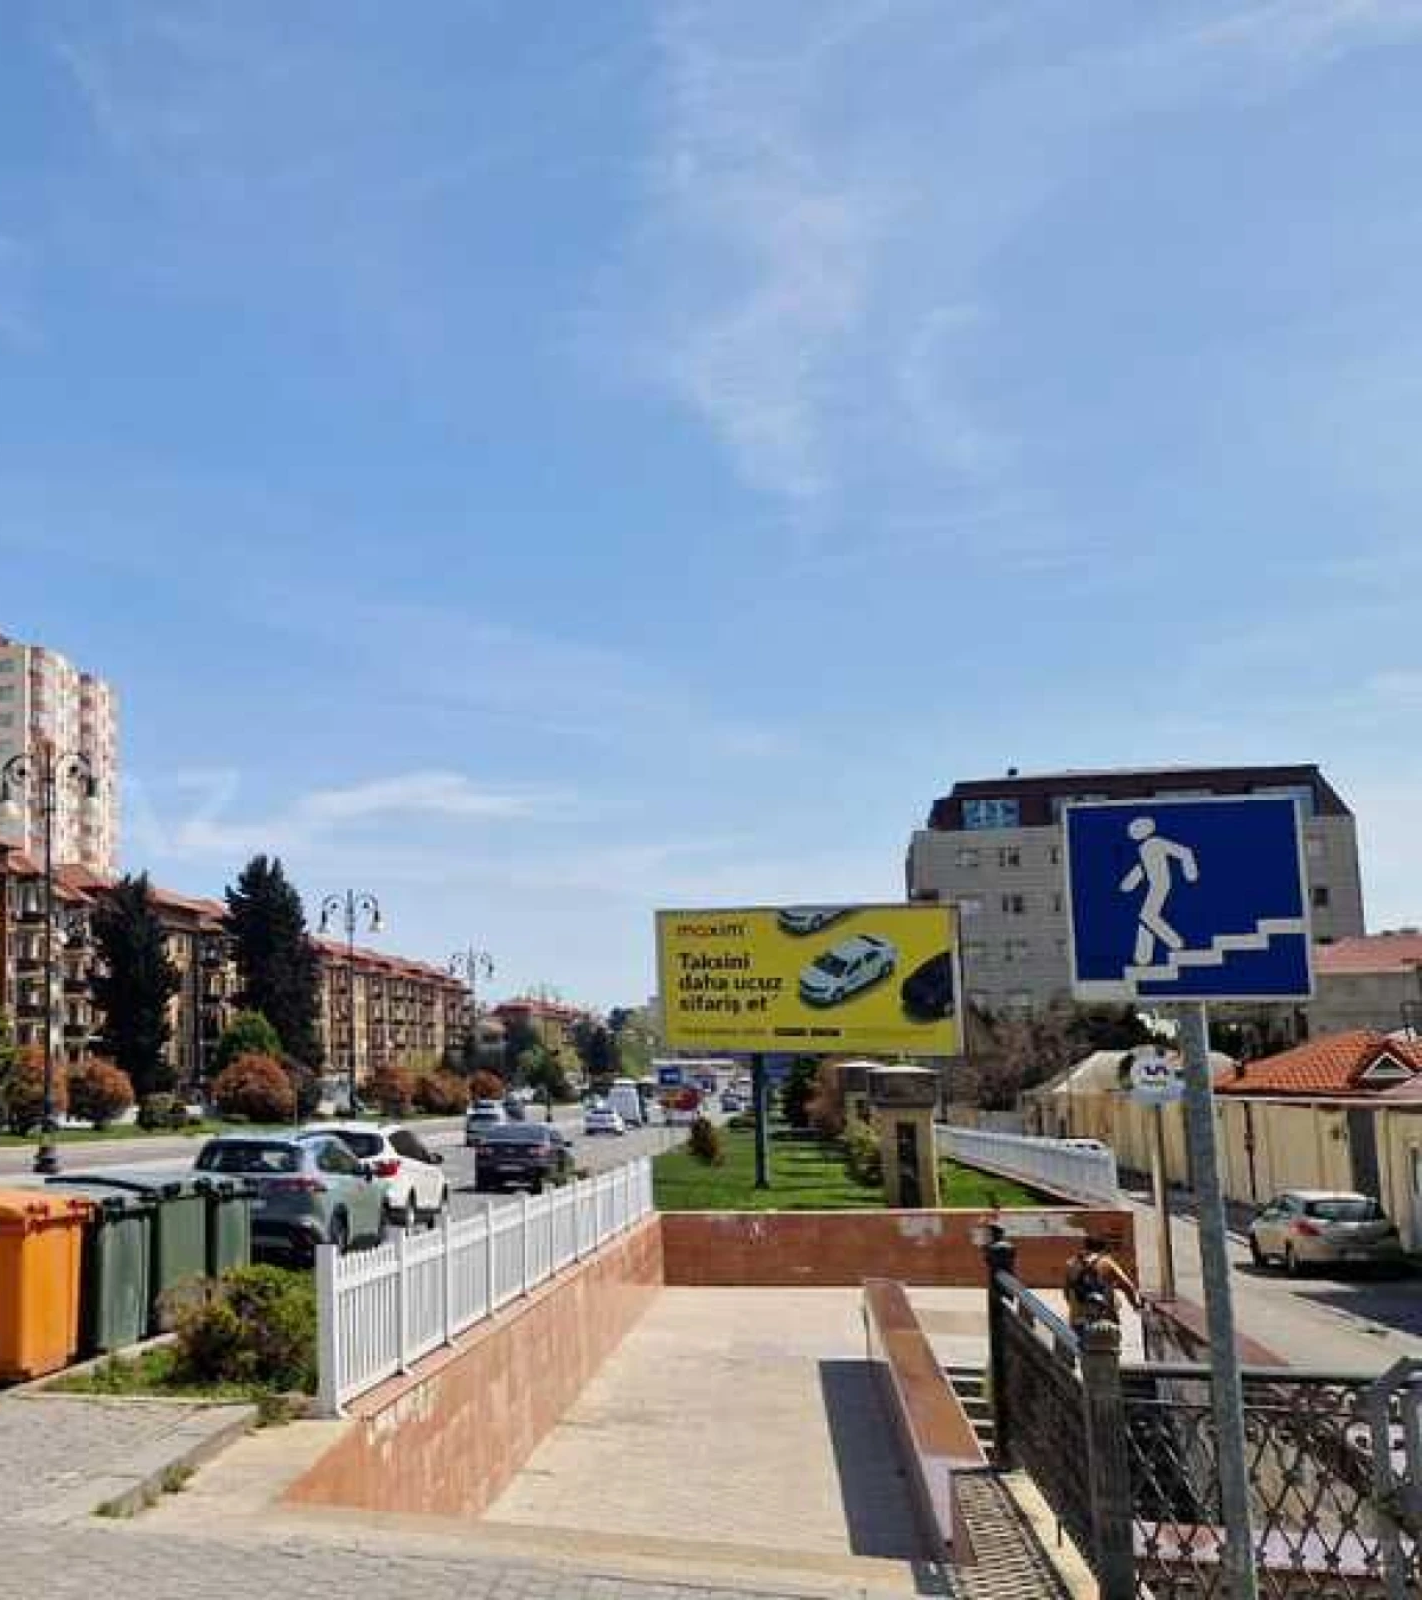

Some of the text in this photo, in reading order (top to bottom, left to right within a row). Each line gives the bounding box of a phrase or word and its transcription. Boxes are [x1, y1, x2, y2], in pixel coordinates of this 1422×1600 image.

[677, 921, 742, 936] maxim
[678, 951, 751, 970] Taksini
[680, 973, 783, 990] daha ucuz
[679, 994, 739, 1014] sifariş
